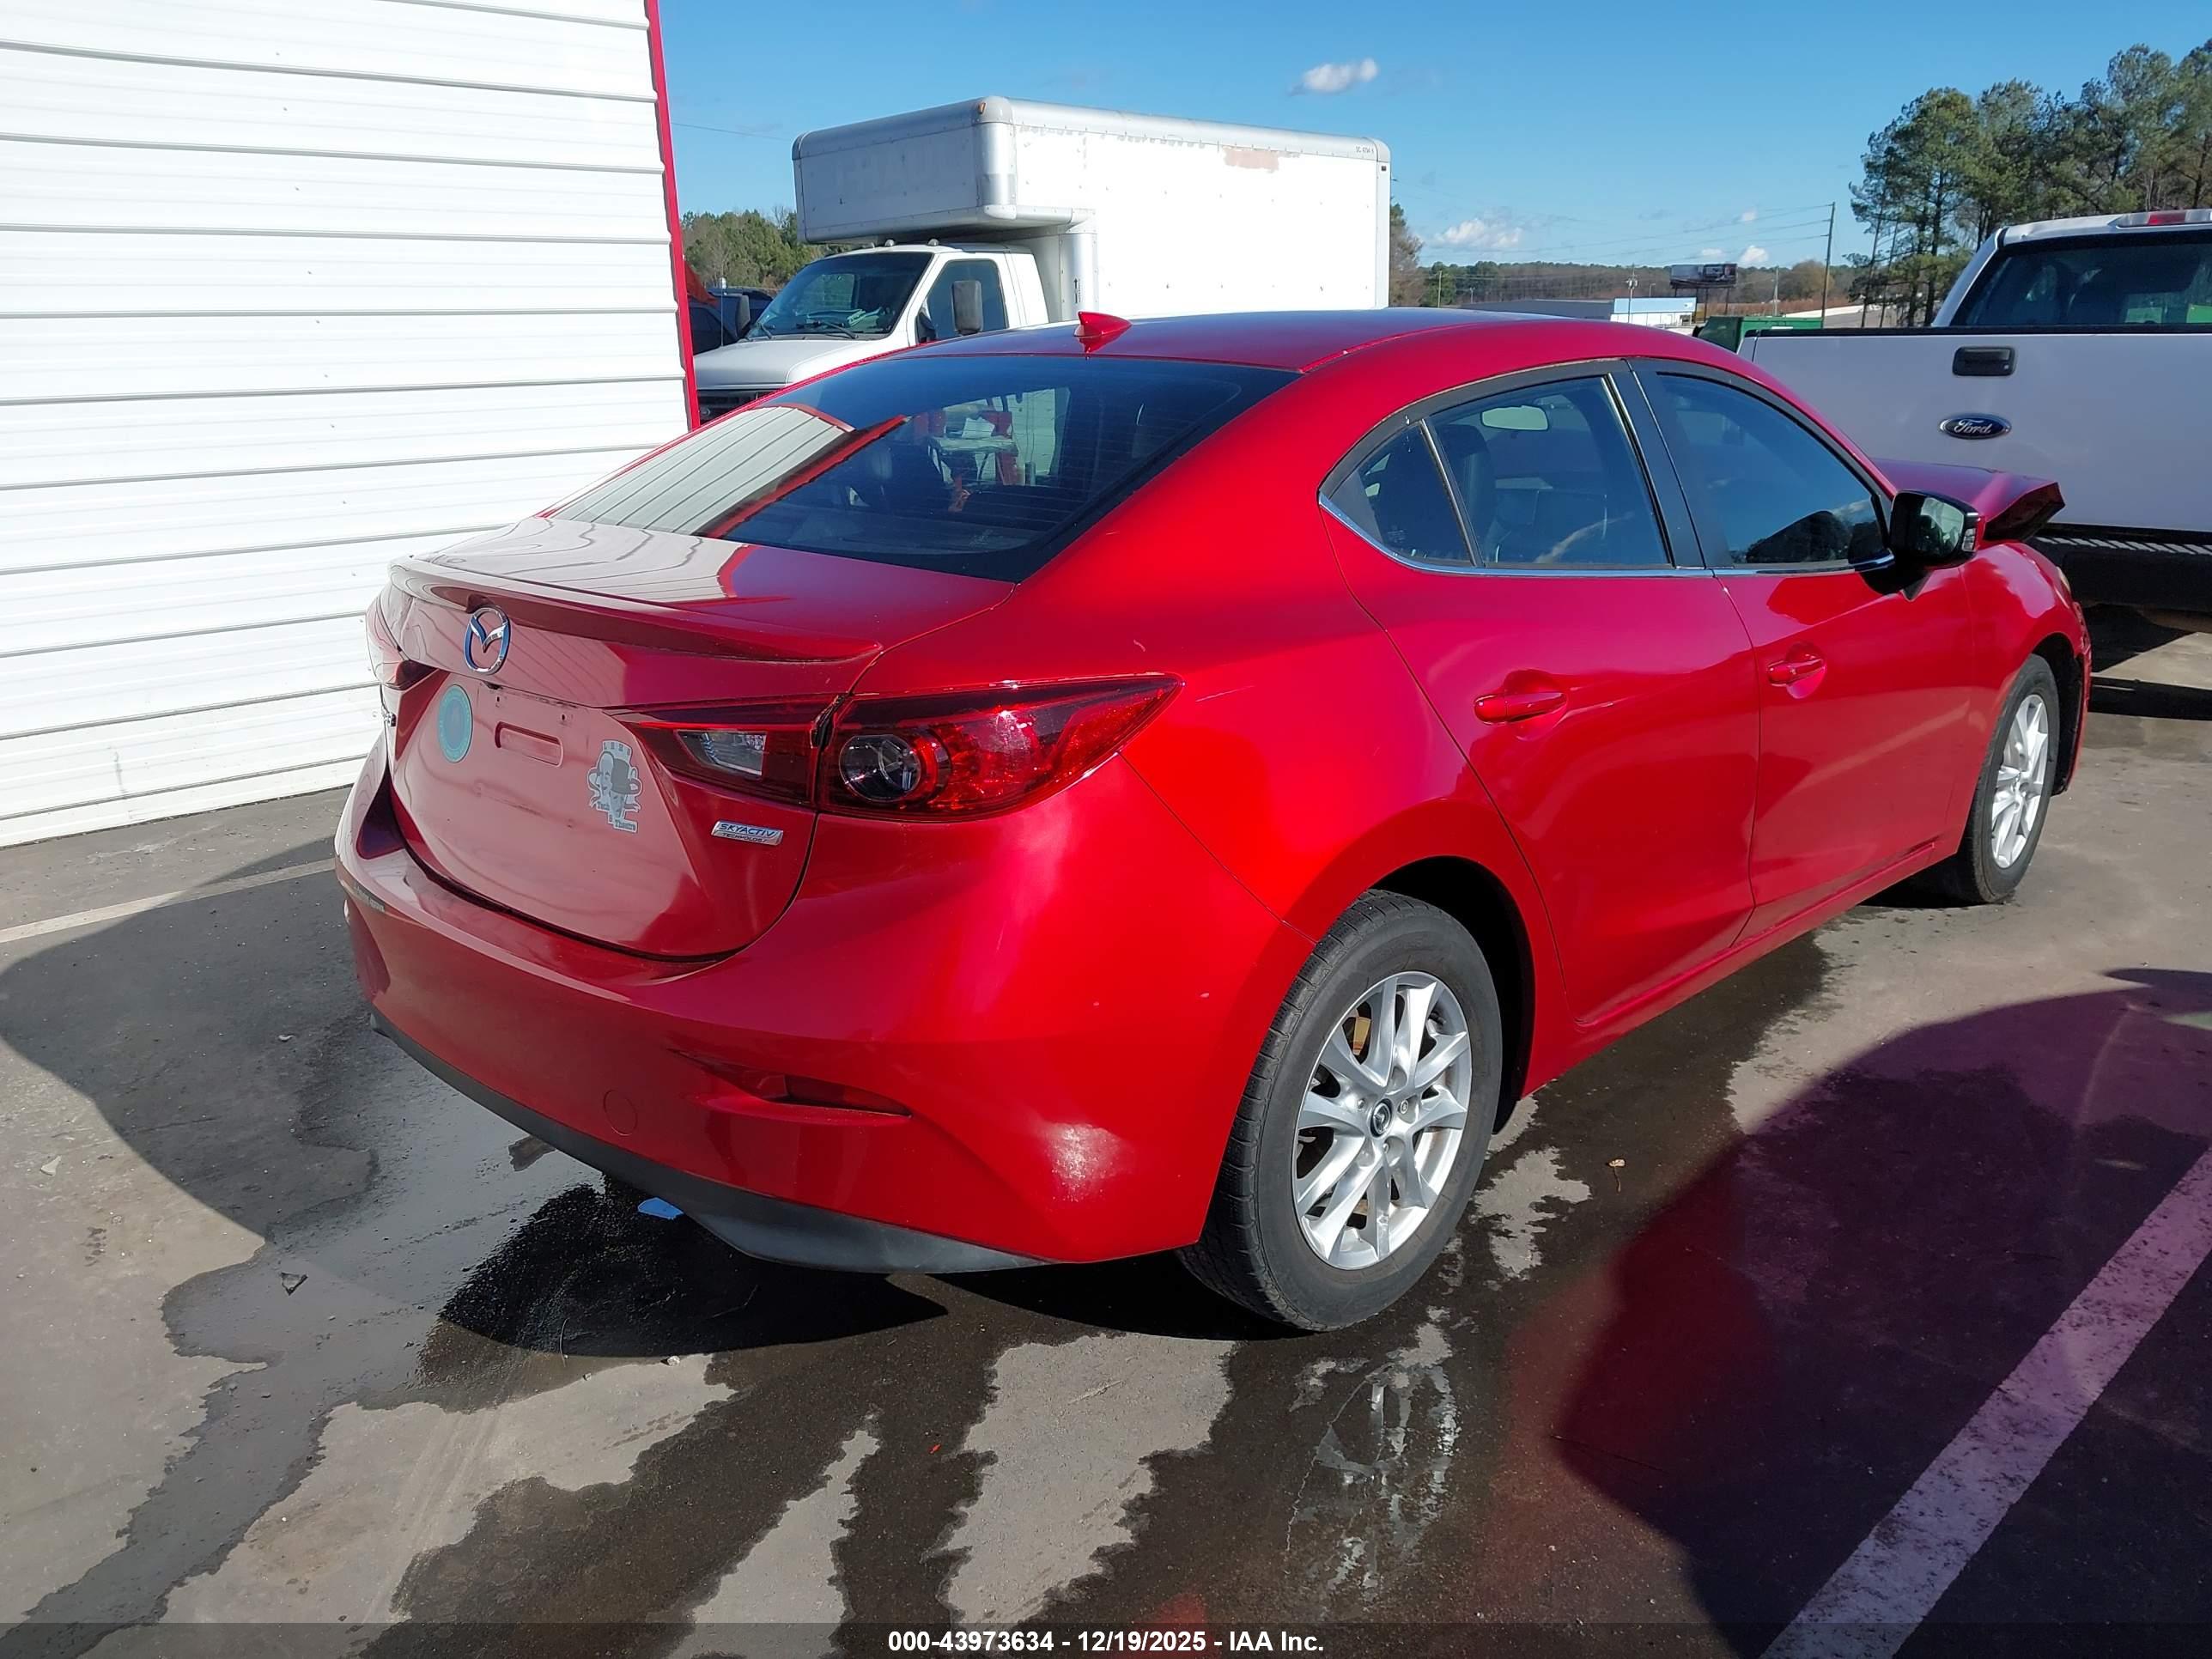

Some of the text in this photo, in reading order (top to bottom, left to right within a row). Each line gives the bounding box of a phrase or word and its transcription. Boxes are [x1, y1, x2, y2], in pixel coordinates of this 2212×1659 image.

[1954, 418, 1993, 434] Ford
[720, 823, 777, 838] SKYACTIV
[721, 832, 769, 843] TECHNOLOGY
